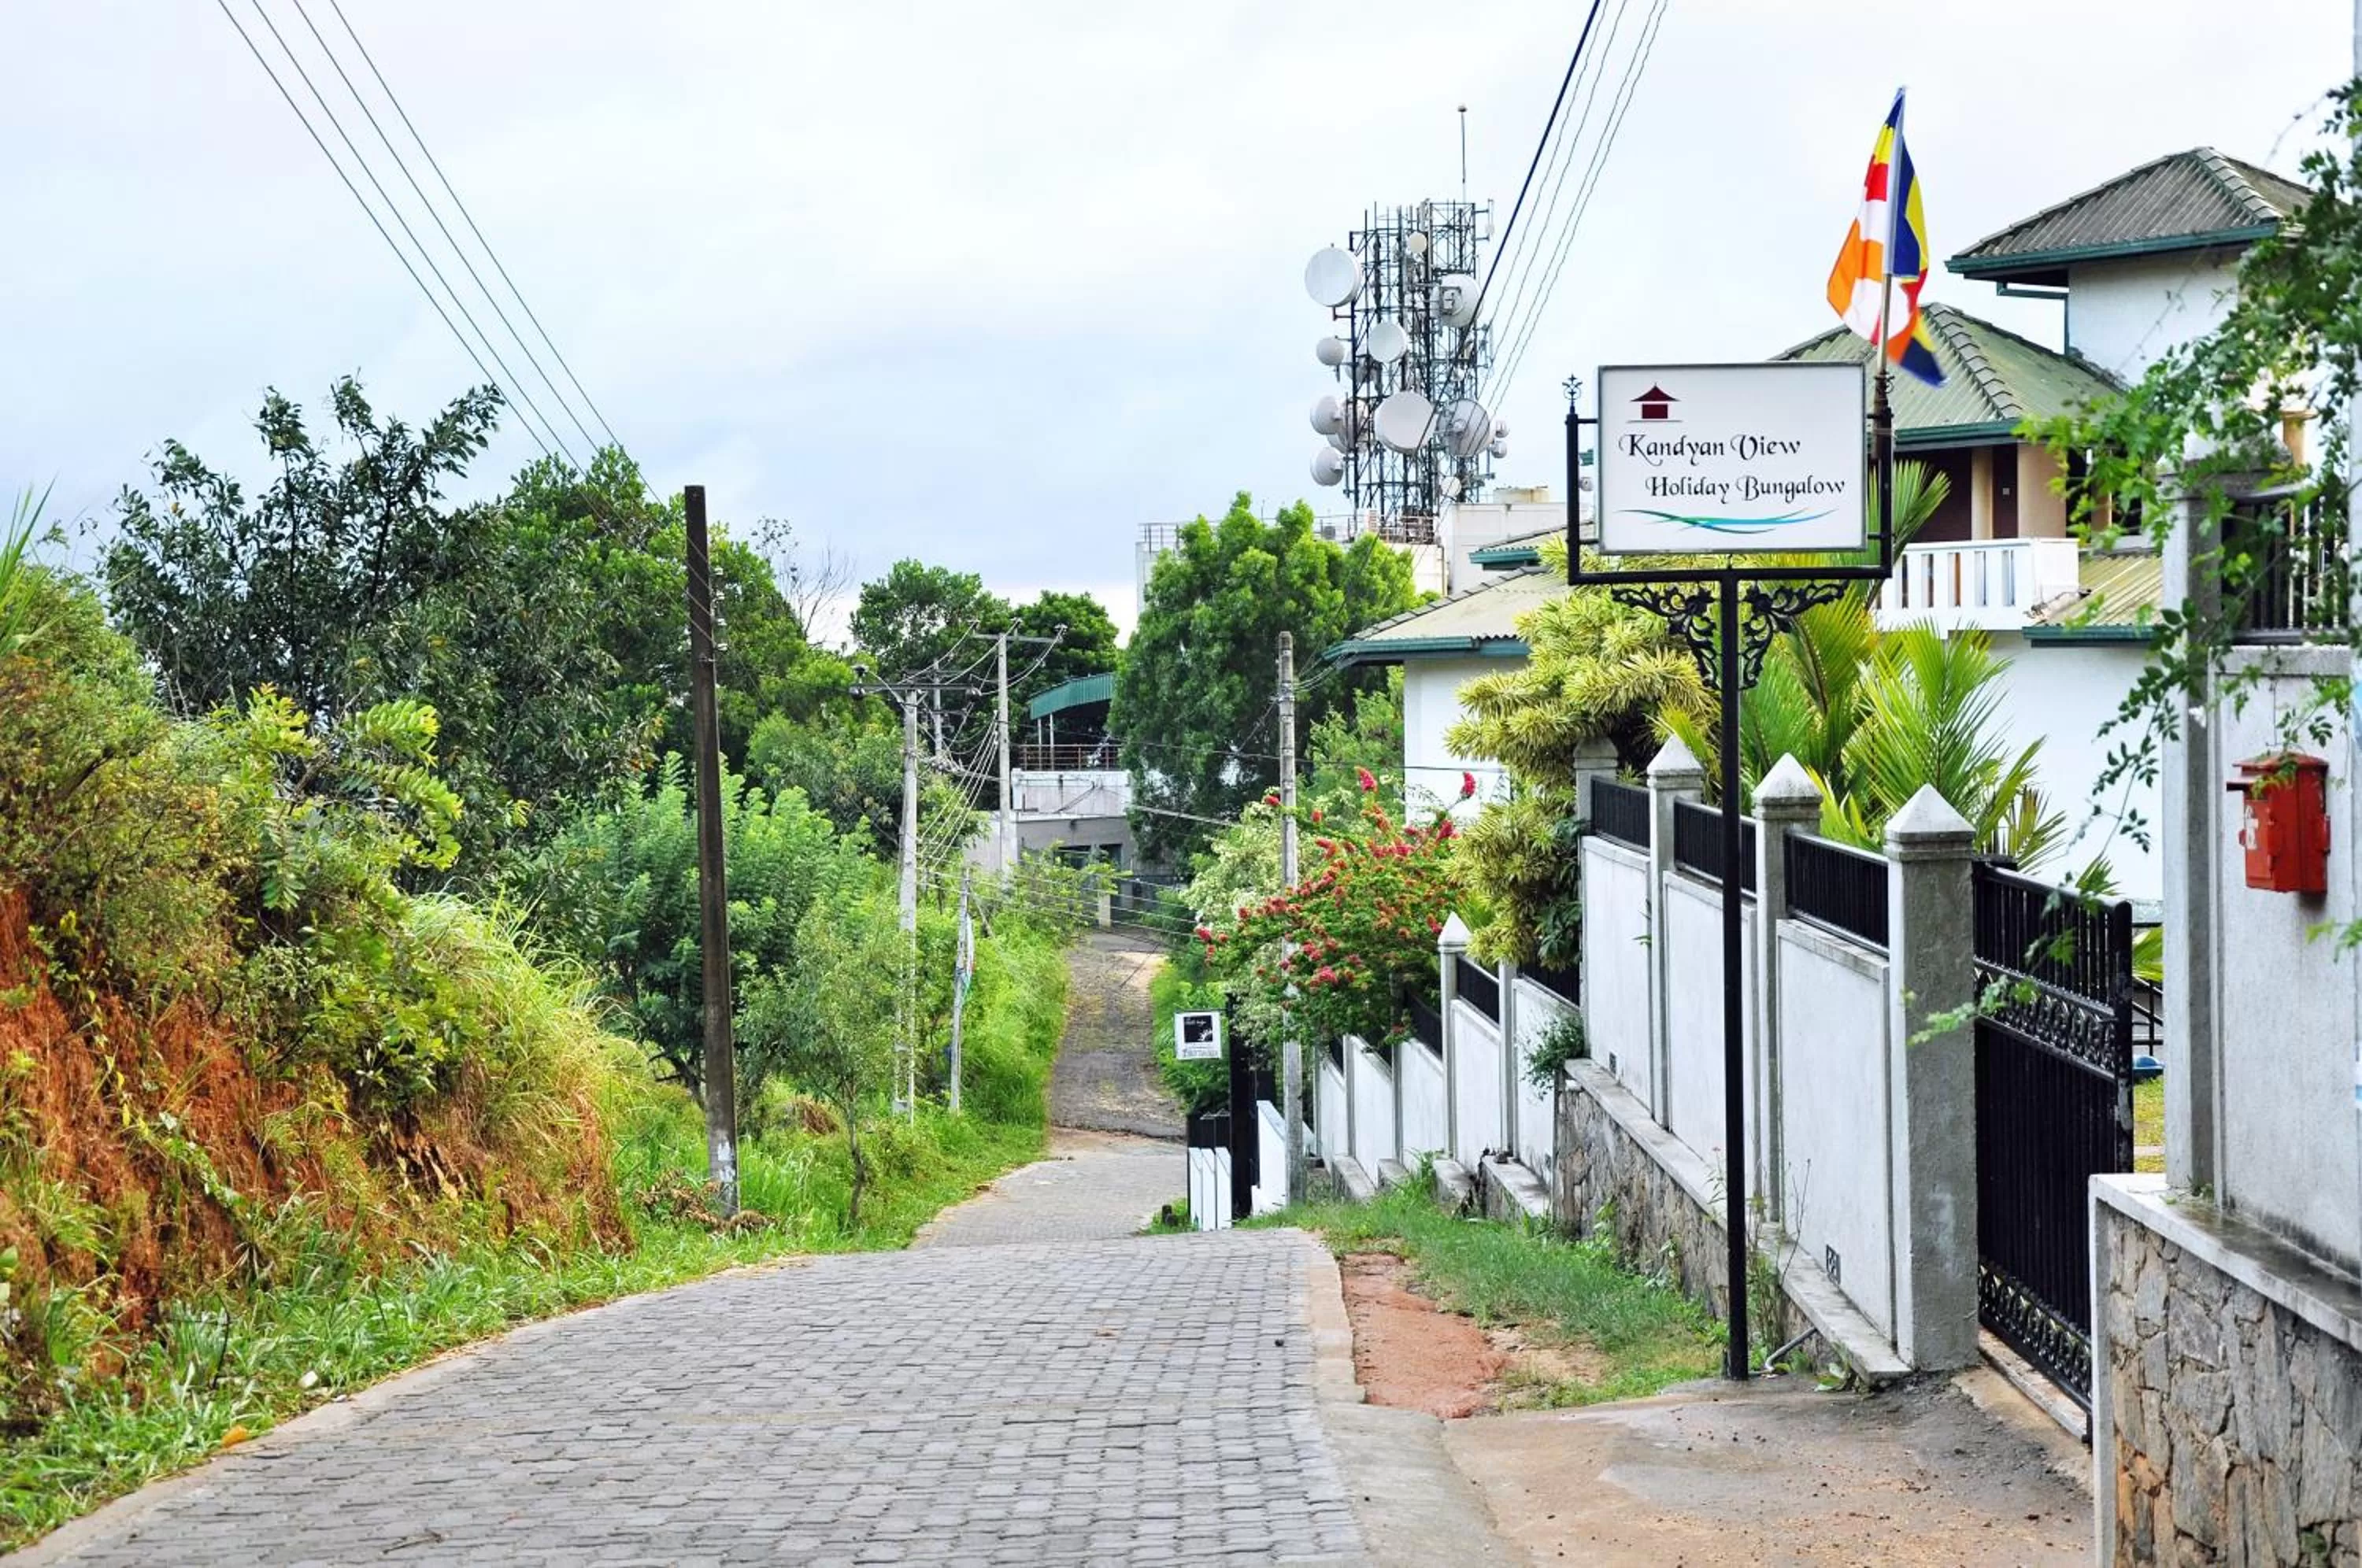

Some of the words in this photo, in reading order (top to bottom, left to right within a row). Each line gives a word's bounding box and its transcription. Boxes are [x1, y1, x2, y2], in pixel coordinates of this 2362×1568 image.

[1618, 433, 1725, 467] Kandyan
[1730, 434, 1801, 461] View
[1645, 475, 1730, 505] Holiday
[1734, 474, 1846, 505] Bungalow
